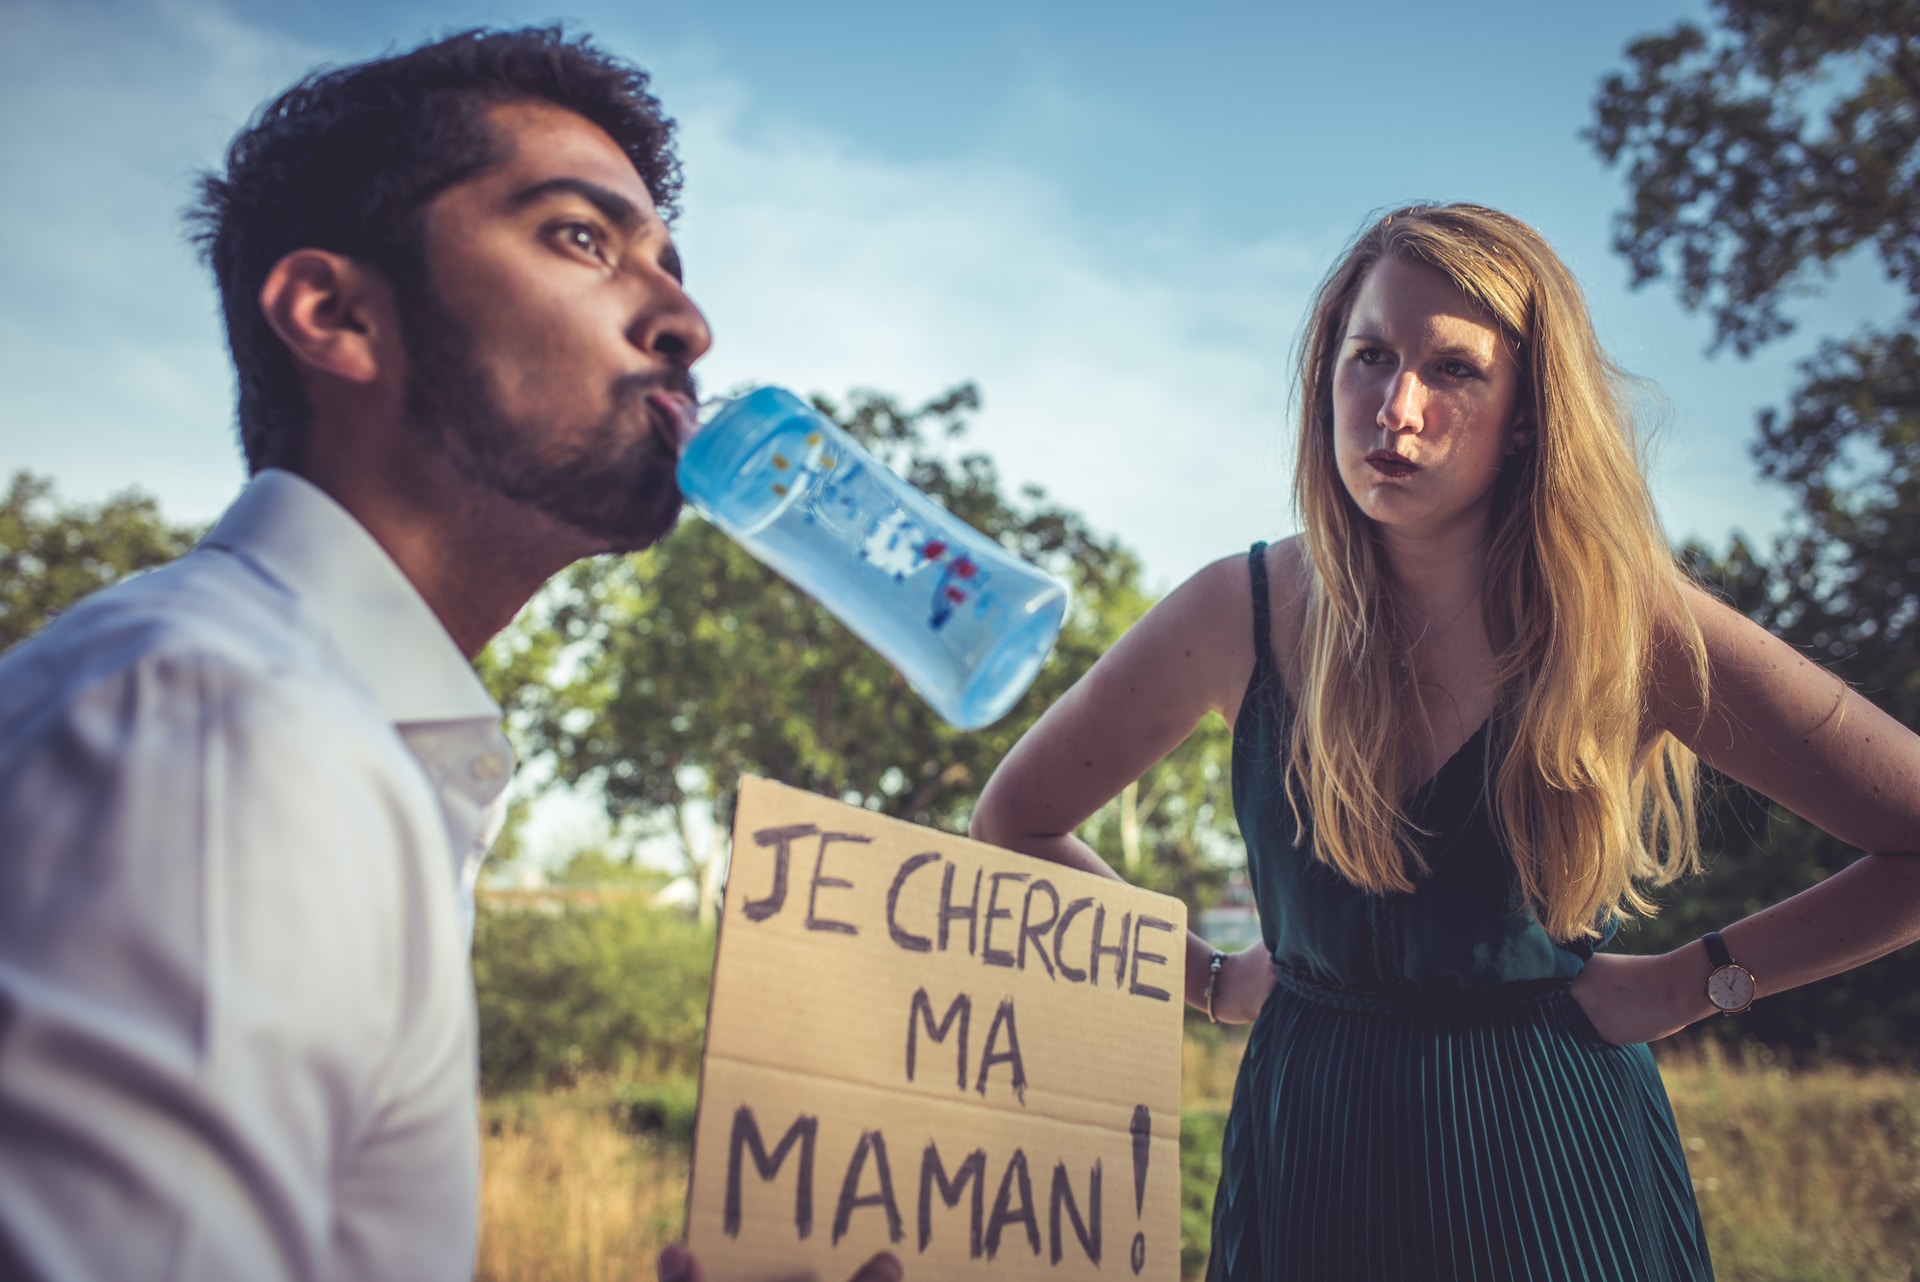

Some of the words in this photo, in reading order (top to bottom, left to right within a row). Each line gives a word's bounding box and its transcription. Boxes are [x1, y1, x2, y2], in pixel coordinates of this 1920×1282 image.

[742, 823, 875, 935] JE
[886, 851, 1178, 1002] CHERCHE
[905, 986, 1028, 1107] MA
